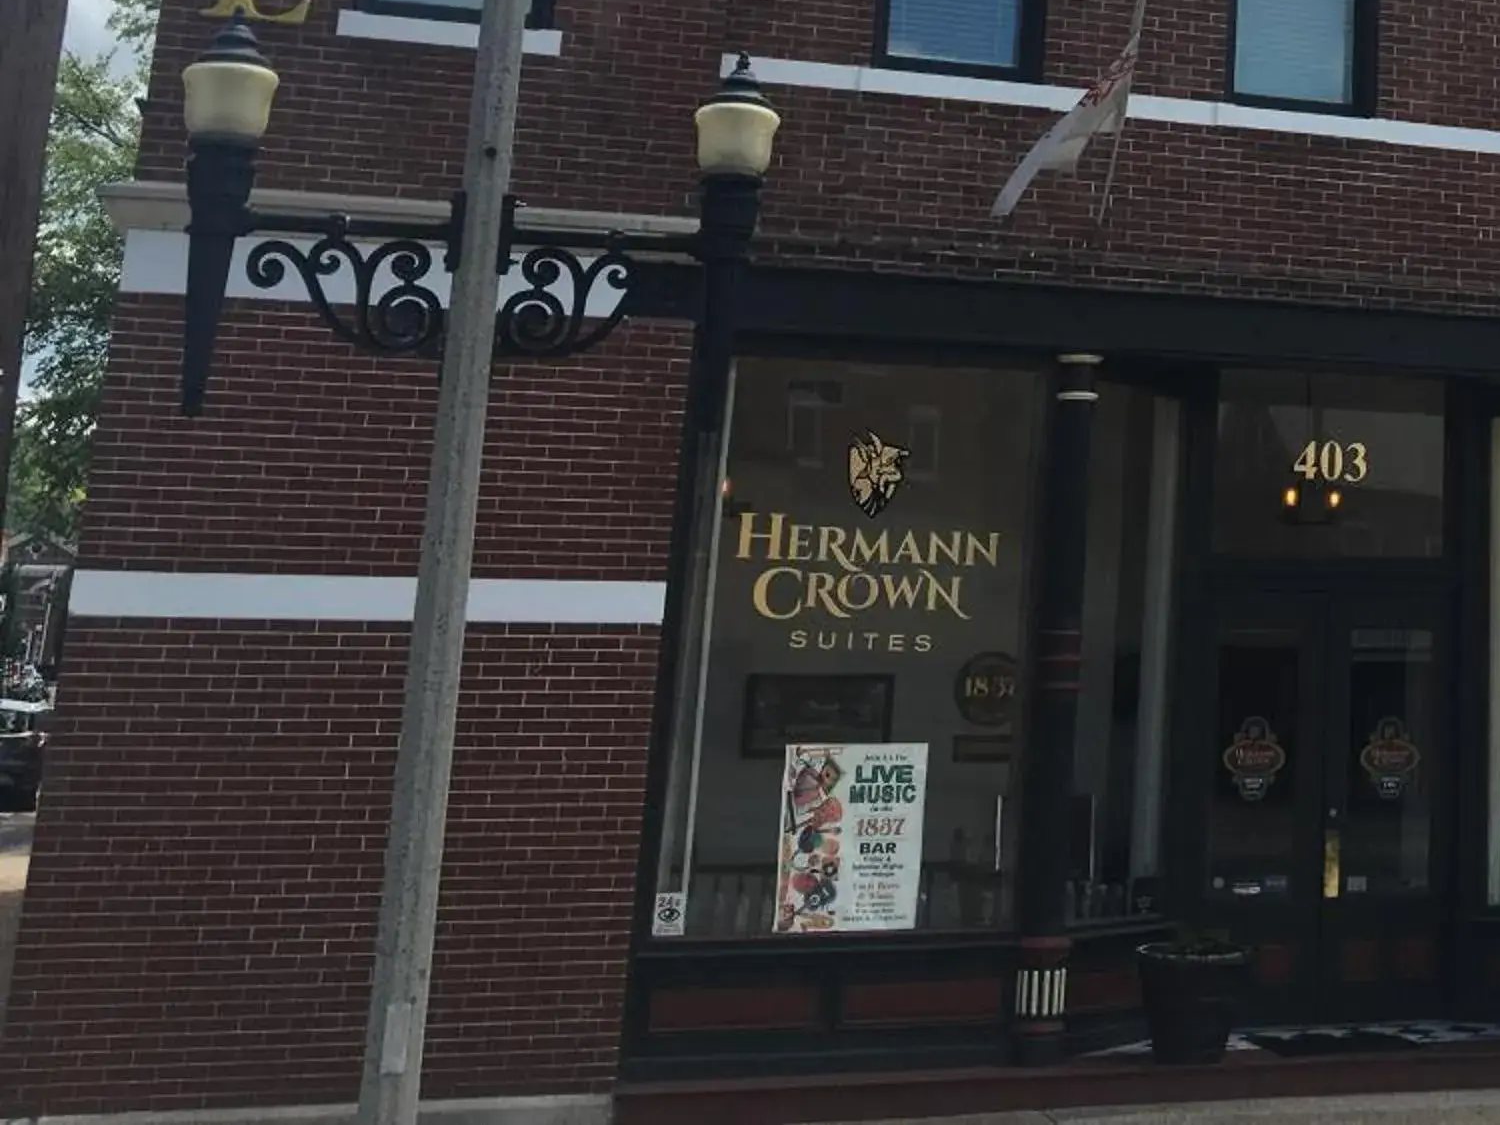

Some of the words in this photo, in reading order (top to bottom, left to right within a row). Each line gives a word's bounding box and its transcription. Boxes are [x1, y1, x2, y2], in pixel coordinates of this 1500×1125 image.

[1293, 440, 1367, 482] 403
[735, 512, 1000, 572] HERMANN
[753, 566, 972, 620] CROWN
[789, 630, 933, 652] SUITES
[855, 764, 914, 784] LIVE
[849, 784, 917, 804] MUSIC
[859, 842, 897, 854] BAR
